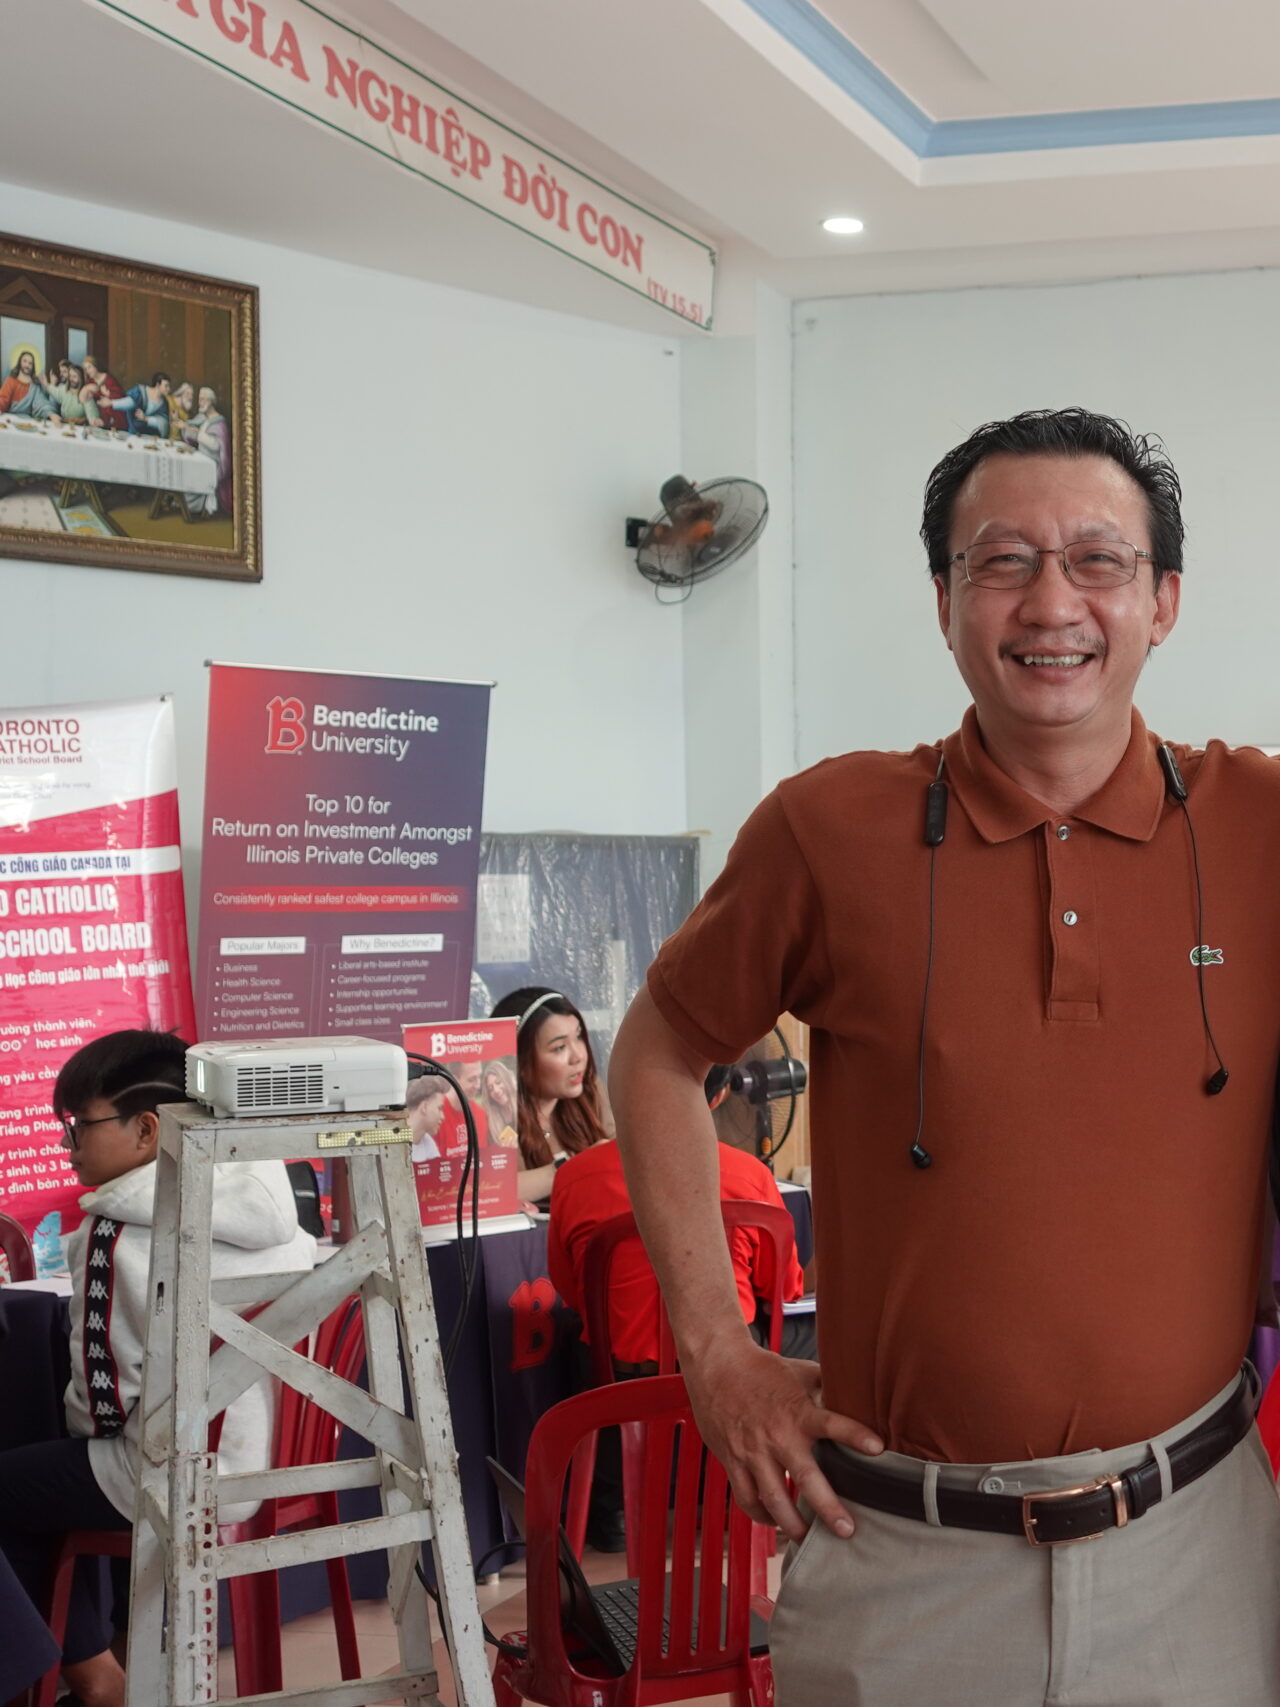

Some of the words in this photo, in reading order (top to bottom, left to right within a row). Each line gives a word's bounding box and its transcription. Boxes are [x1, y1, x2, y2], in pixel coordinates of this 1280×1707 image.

[209, 0, 310, 82] GIA
[322, 44, 491, 181] NGHIỆP
[502, 153, 571, 233] ĐỜI
[577, 202, 644, 274] CON
[312, 704, 440, 733] Benedictine
[0, 718, 80, 736] RONTO
[311, 730, 411, 762] University
[17, 756, 50, 765] School
[53, 755, 83, 764] Board
[305, 793, 340, 817] Top
[345, 794, 365, 814] 10
[368, 795, 392, 815] for
[212, 818, 272, 838] Return
[276, 822, 298, 838] on
[304, 820, 396, 840] Investment
[399, 822, 473, 845] Amongst
[246, 844, 300, 864] Illinois
[305, 845, 365, 865] Private
[368, 846, 439, 869] Colleges
[10, 856, 39, 873] CÔNG
[42, 856, 67, 871] GIÁO
[15, 883, 117, 916] CATHOLIC
[213, 892, 275, 907] Consistently
[278, 893, 311, 905] ranked
[314, 892, 344, 904] safest
[346, 893, 379, 907] college
[381, 894, 418, 906] campus
[419, 893, 428, 904] in
[430, 892, 459, 904] Illinois
[81, 922, 152, 952] BOARD
[349, 938, 370, 951] Why
[374, 937, 436, 949] Benedictine?
[227, 941, 264, 953] Popular
[267, 940, 299, 953] Majors
[223, 963, 258, 973] Business
[222, 977, 248, 988] Health
[250, 977, 280, 987] Science
[221, 992, 262, 1004] Computer
[263, 991, 294, 1001] Science
[220, 1007, 268, 1019] Engineering
[269, 1005, 300, 1016] Science
[33, 1018, 67, 1032] thành
[219, 1022, 254, 1032] Nutrition
[255, 1021, 271, 1031] and
[36, 1037, 57, 1050] học
[60, 1034, 83, 1047] sinh
[447, 1031, 494, 1044] Benedictine
[447, 1044, 484, 1055] University
[13, 1070, 35, 1085] yêu
[6, 1164, 30, 1178] sinh
[49, 1160, 57, 1172] 3
